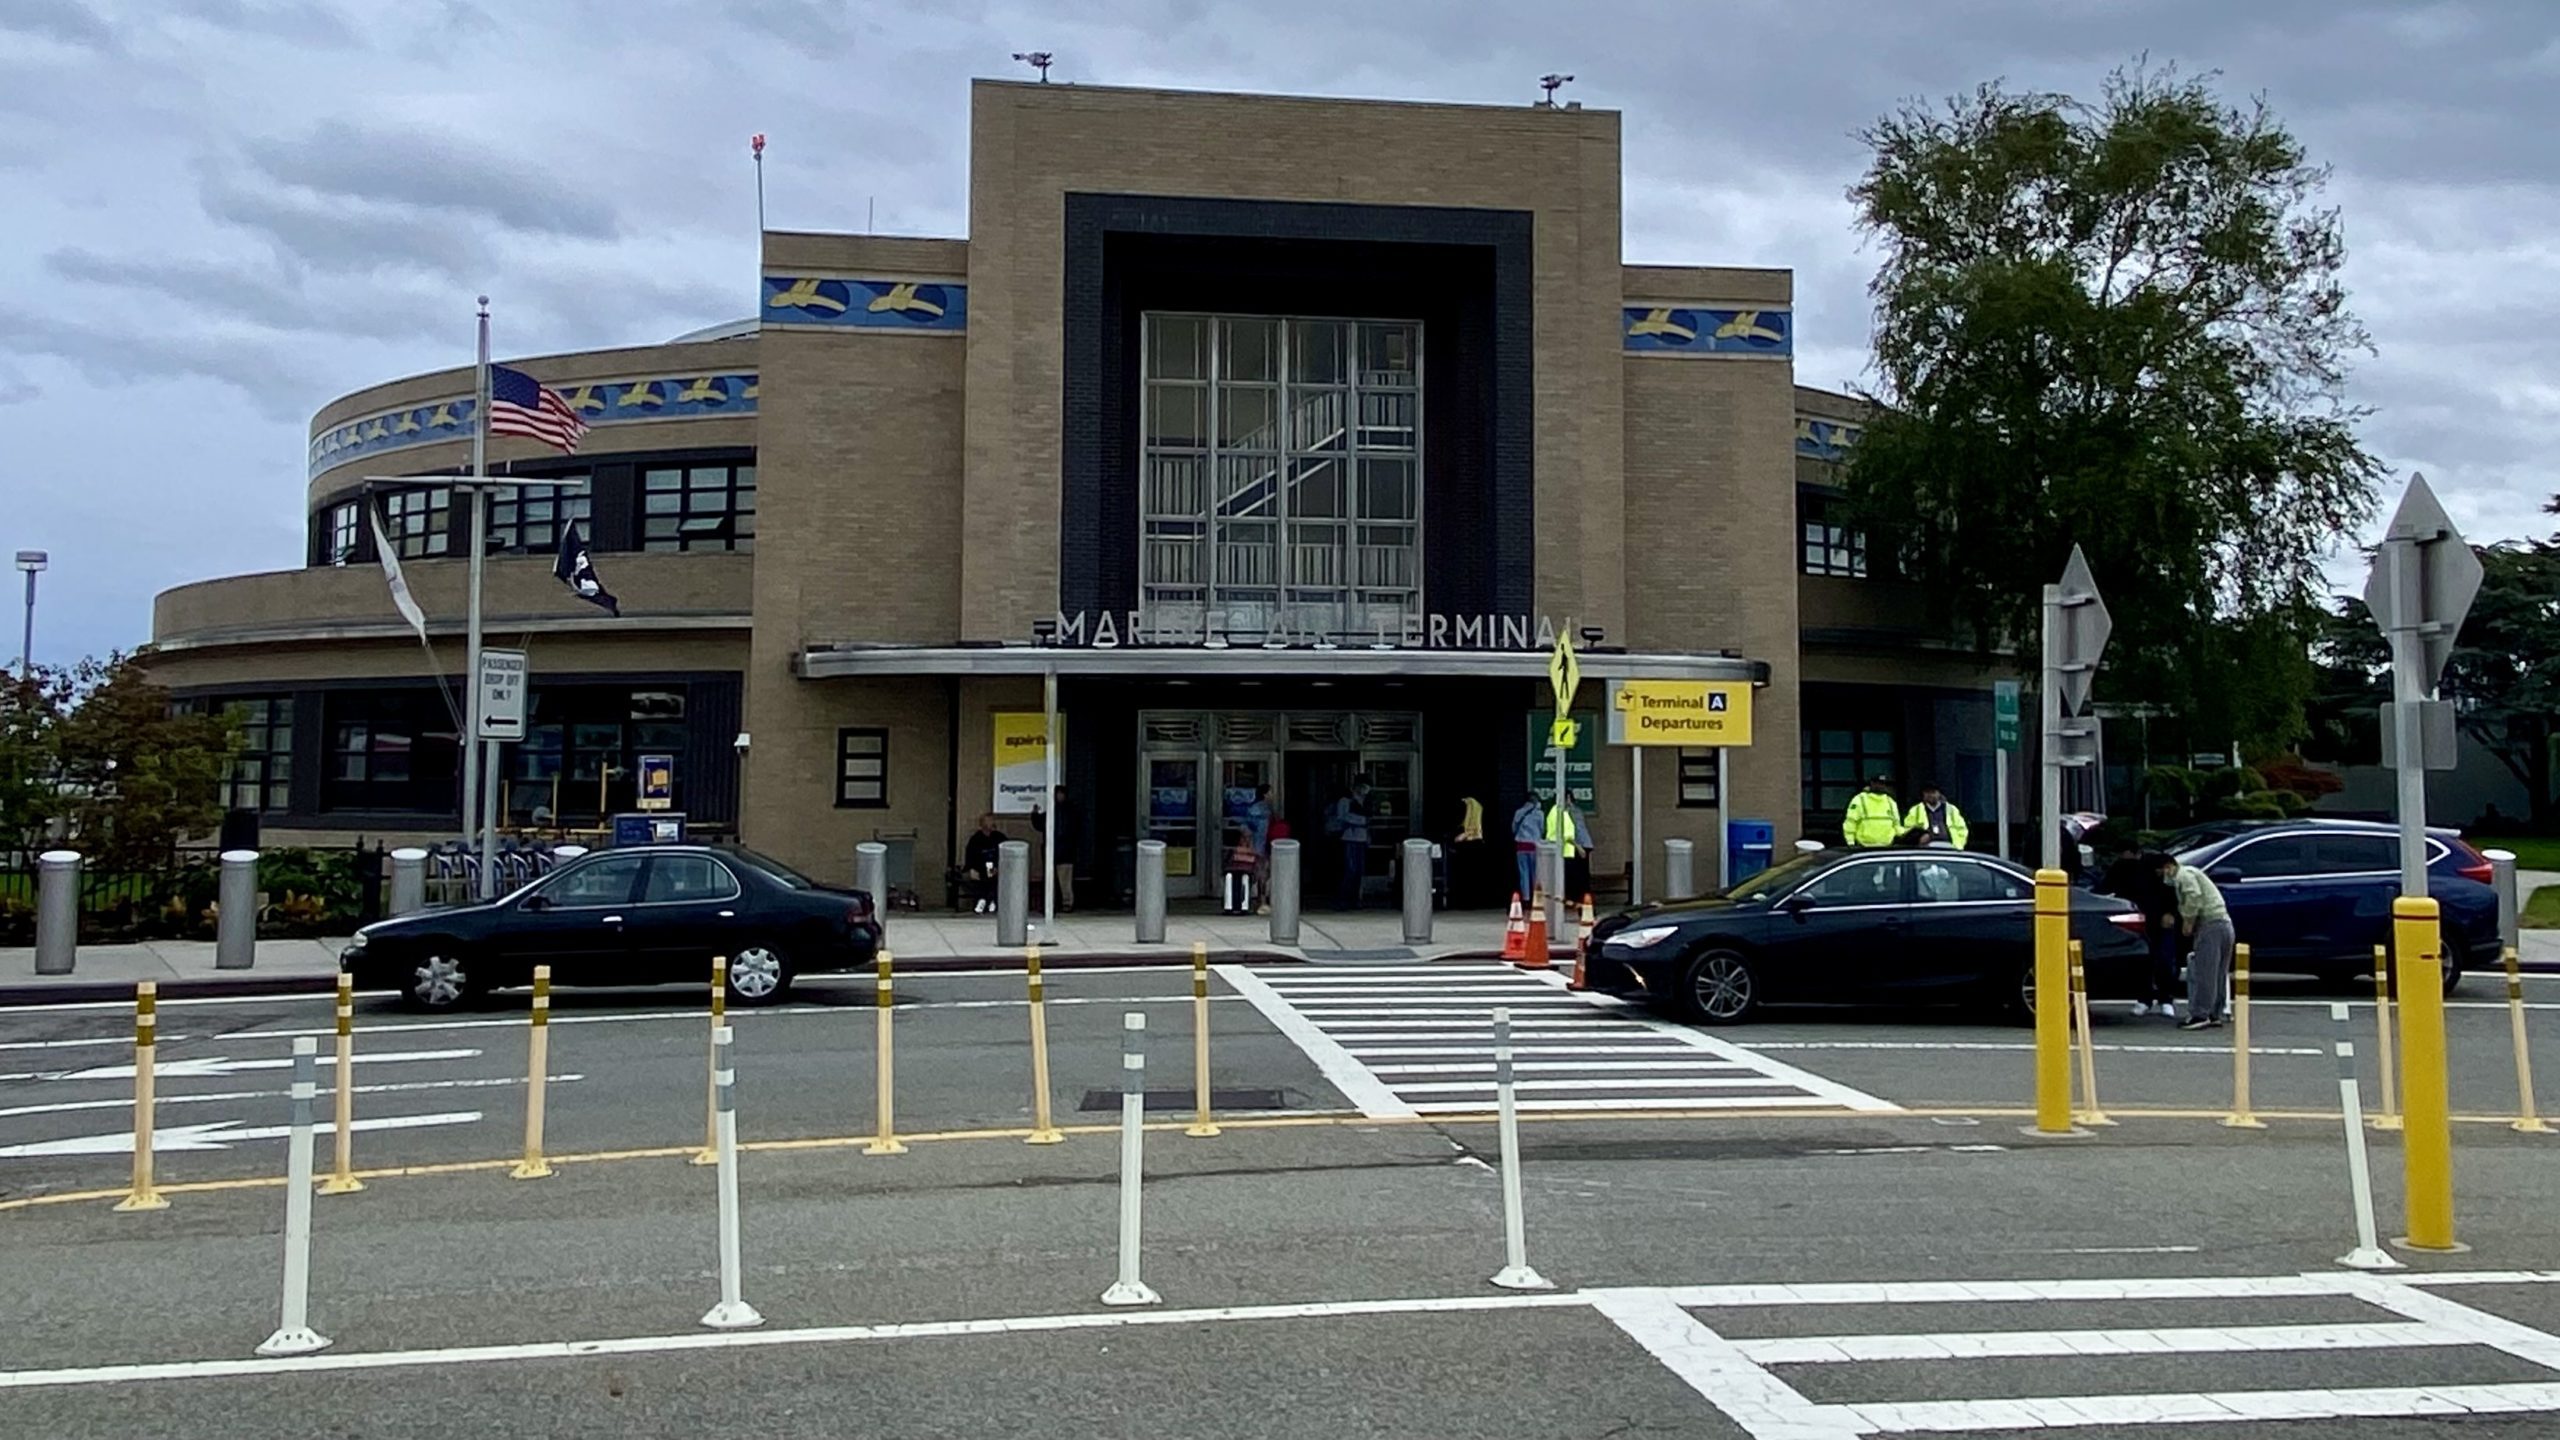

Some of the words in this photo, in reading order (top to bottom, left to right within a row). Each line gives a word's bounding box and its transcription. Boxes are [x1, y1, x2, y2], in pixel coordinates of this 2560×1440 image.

[1641, 694, 1704, 709] Terminal
[1641, 715, 1724, 732] Departures
[1534, 762, 1593, 772] FROTIER
[1000, 783, 1047, 794] Departure
